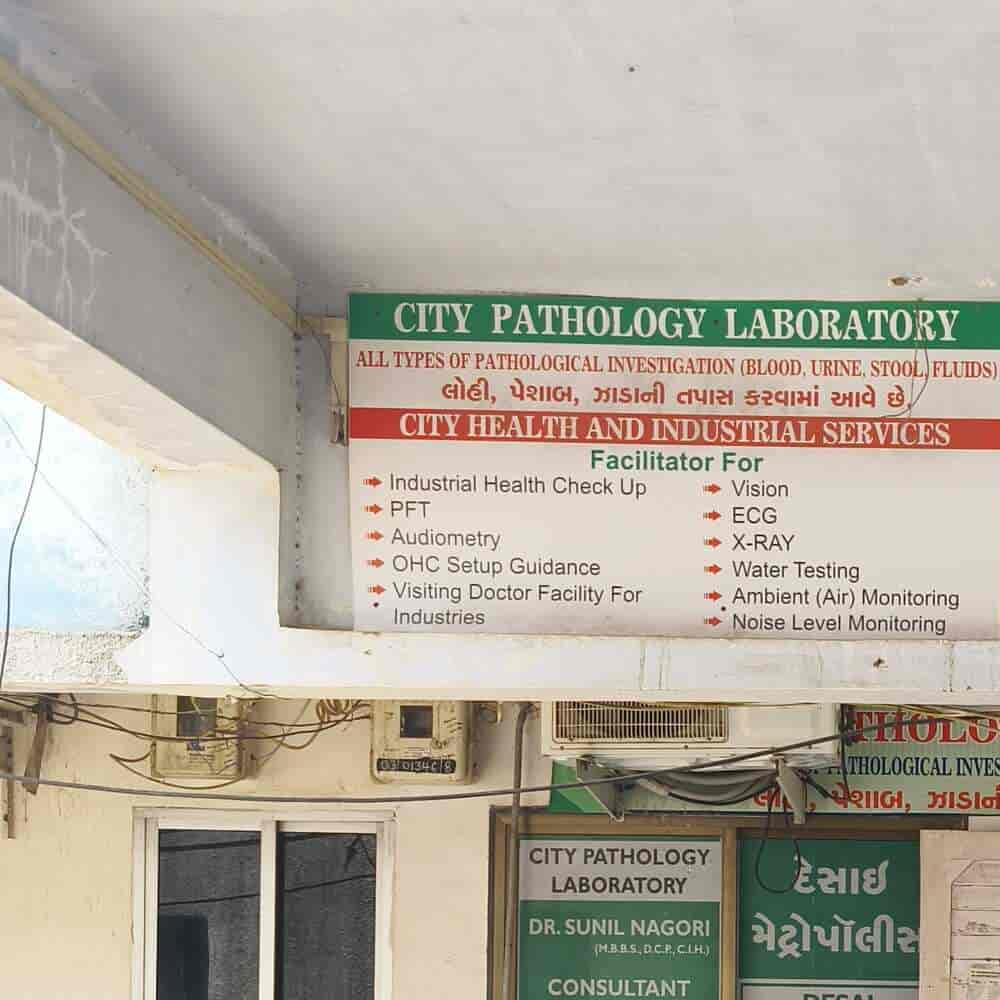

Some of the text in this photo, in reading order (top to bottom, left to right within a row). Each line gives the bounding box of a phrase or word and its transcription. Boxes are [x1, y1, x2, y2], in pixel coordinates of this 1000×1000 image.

[394, 302, 960, 342] CITY PATHOLOGY LABORATORY
[356, 350, 389, 369] ALL
[392, 351, 445, 369] TYPES
[450, 352, 471, 369] OF
[475, 353, 604, 373] PATHOLOGICAL
[607, 355, 735, 375] INVESTIGATION
[933, 360, 998, 379] FLUIDS)
[441, 376, 497, 404] લોહી,
[510, 377, 580, 407] પેશાબ,
[592, 381, 666, 405] ઝાડાની
[676, 388, 734, 407] તપાસ
[745, 385, 820, 408] કરવામાં
[831, 384, 876, 409] આવે
[399, 412, 950, 446] CITY HEALTH AND INDUSTRIAL SERVICES
[590, 450, 764, 473] Facilitator For
[390, 473, 648, 499] Industrial Health Check Up
[731, 479, 789, 497] Vision
[390, 500, 431, 518] PFT
[732, 506, 778, 524] ECG
[391, 528, 501, 550] Audiometry
[731, 534, 795, 551] X-RAY
[392, 555, 601, 577] OHC Setup Guidance
[732, 560, 860, 583] Water Testing
[392, 582, 644, 606] Visiting Doctor Facility For
[731, 587, 960, 610] Ambient (Air) Monitoring
[394, 608, 486, 626] Industries
[731, 613, 947, 635] Noise Level Monitoring
[529, 847, 711, 866] CITY PATHOLOGY
[551, 876, 688, 894] LABORATORY
[528, 918, 710, 937] DR. SUNIL NAGORI
[548, 978, 691, 997] CONSULTANT
